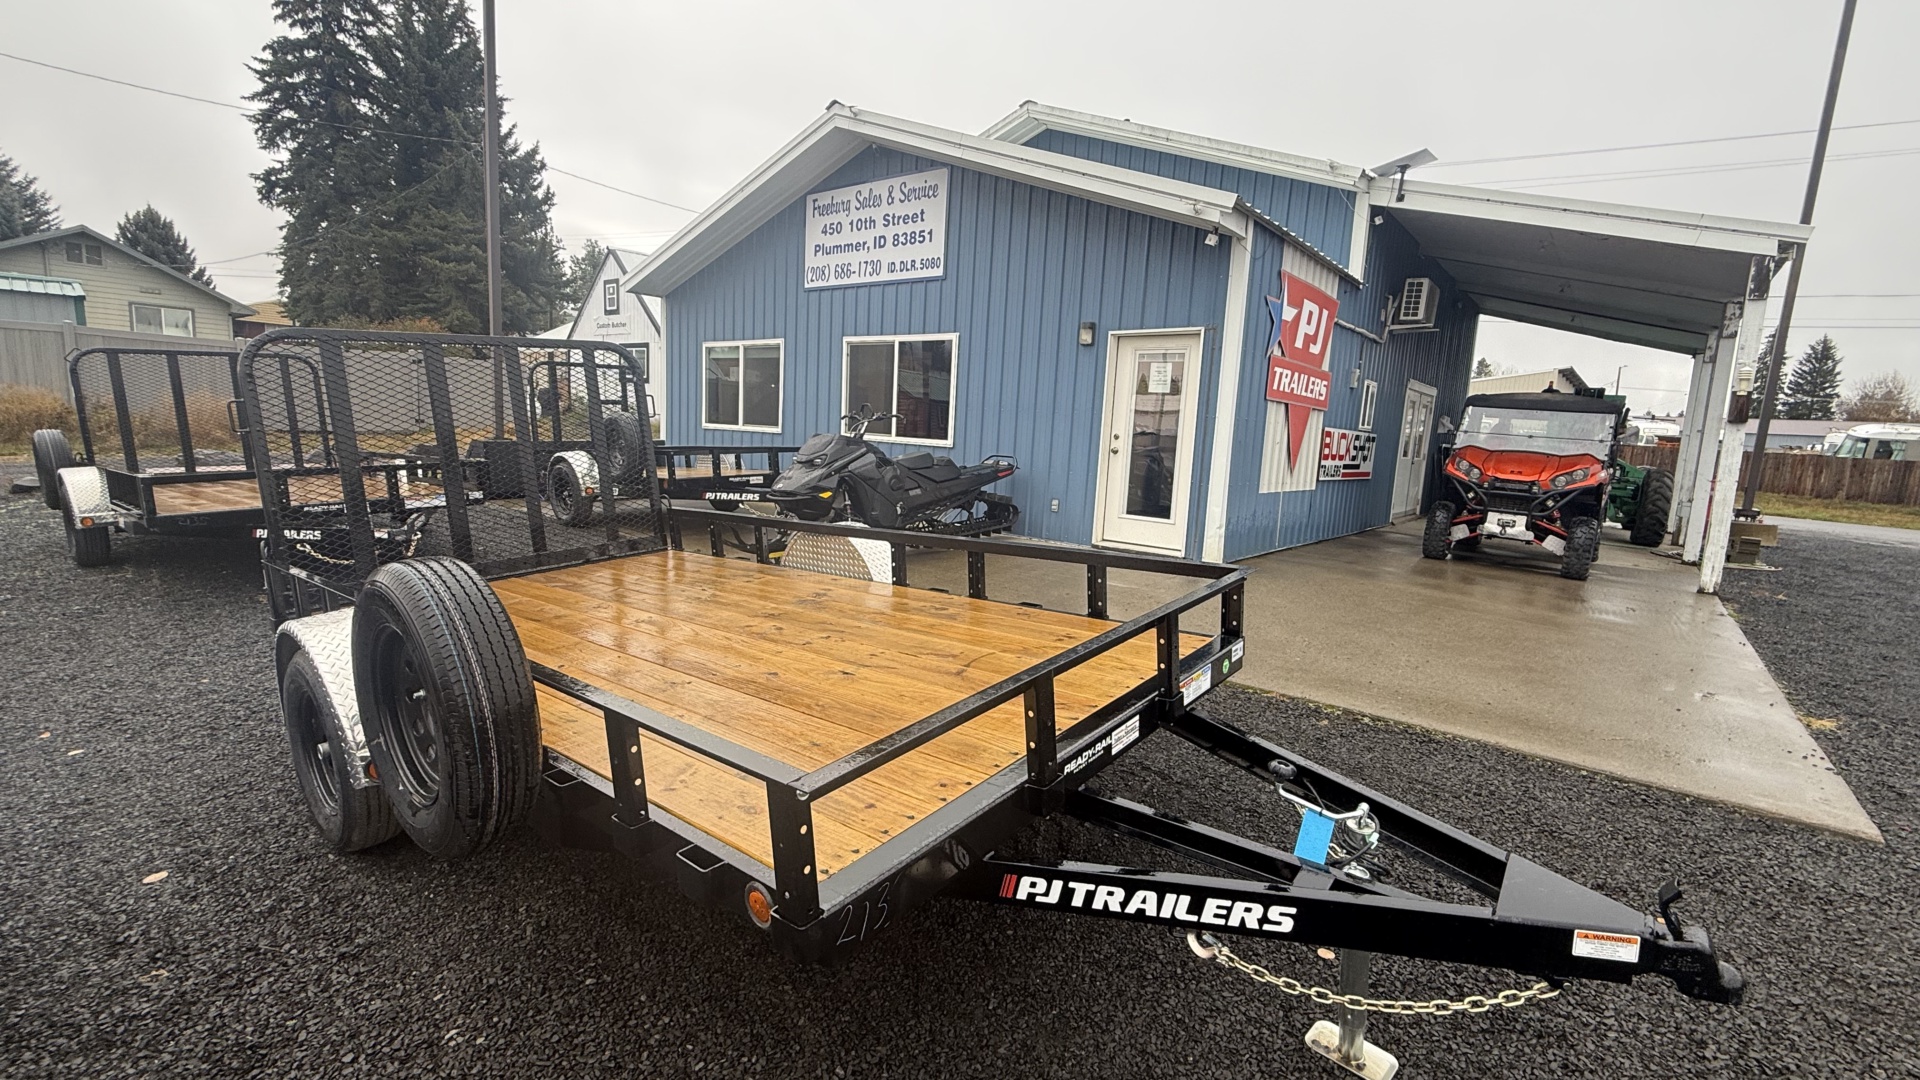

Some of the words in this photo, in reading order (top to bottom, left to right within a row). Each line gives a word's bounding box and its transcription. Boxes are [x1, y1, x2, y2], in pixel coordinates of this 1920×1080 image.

[812, 196, 851, 218] Freeburg
[854, 188, 882, 211] Sales
[887, 185, 895, 206] &
[899, 179, 939, 203] Service
[821, 221, 843, 236] 450
[849, 216, 876, 233] 10th
[882, 208, 925, 228] Street
[814, 240, 871, 257] Plummer,
[873, 235, 887, 250] ID
[892, 229, 933, 247] 83851
[806, 264, 831, 284] (208)
[834, 259, 882, 280] 686-1730
[1294, 298, 1329, 355] PJ
[1272, 366, 1328, 401] TRAILERS
[1322, 430, 1376, 463] BUCKSHOT
[1319, 464, 1342, 478] TRAILERS
[705, 492, 716, 500] PJ
[716, 492, 760, 501] TRAILERS
[256, 529, 268, 538] PJ
[1063, 735, 1113, 776] READY-RAIL
[1015, 876, 1064, 904] PJ
[1067, 881, 1298, 933] TRAILERS
[1592, 933, 1632, 944] WARNING
